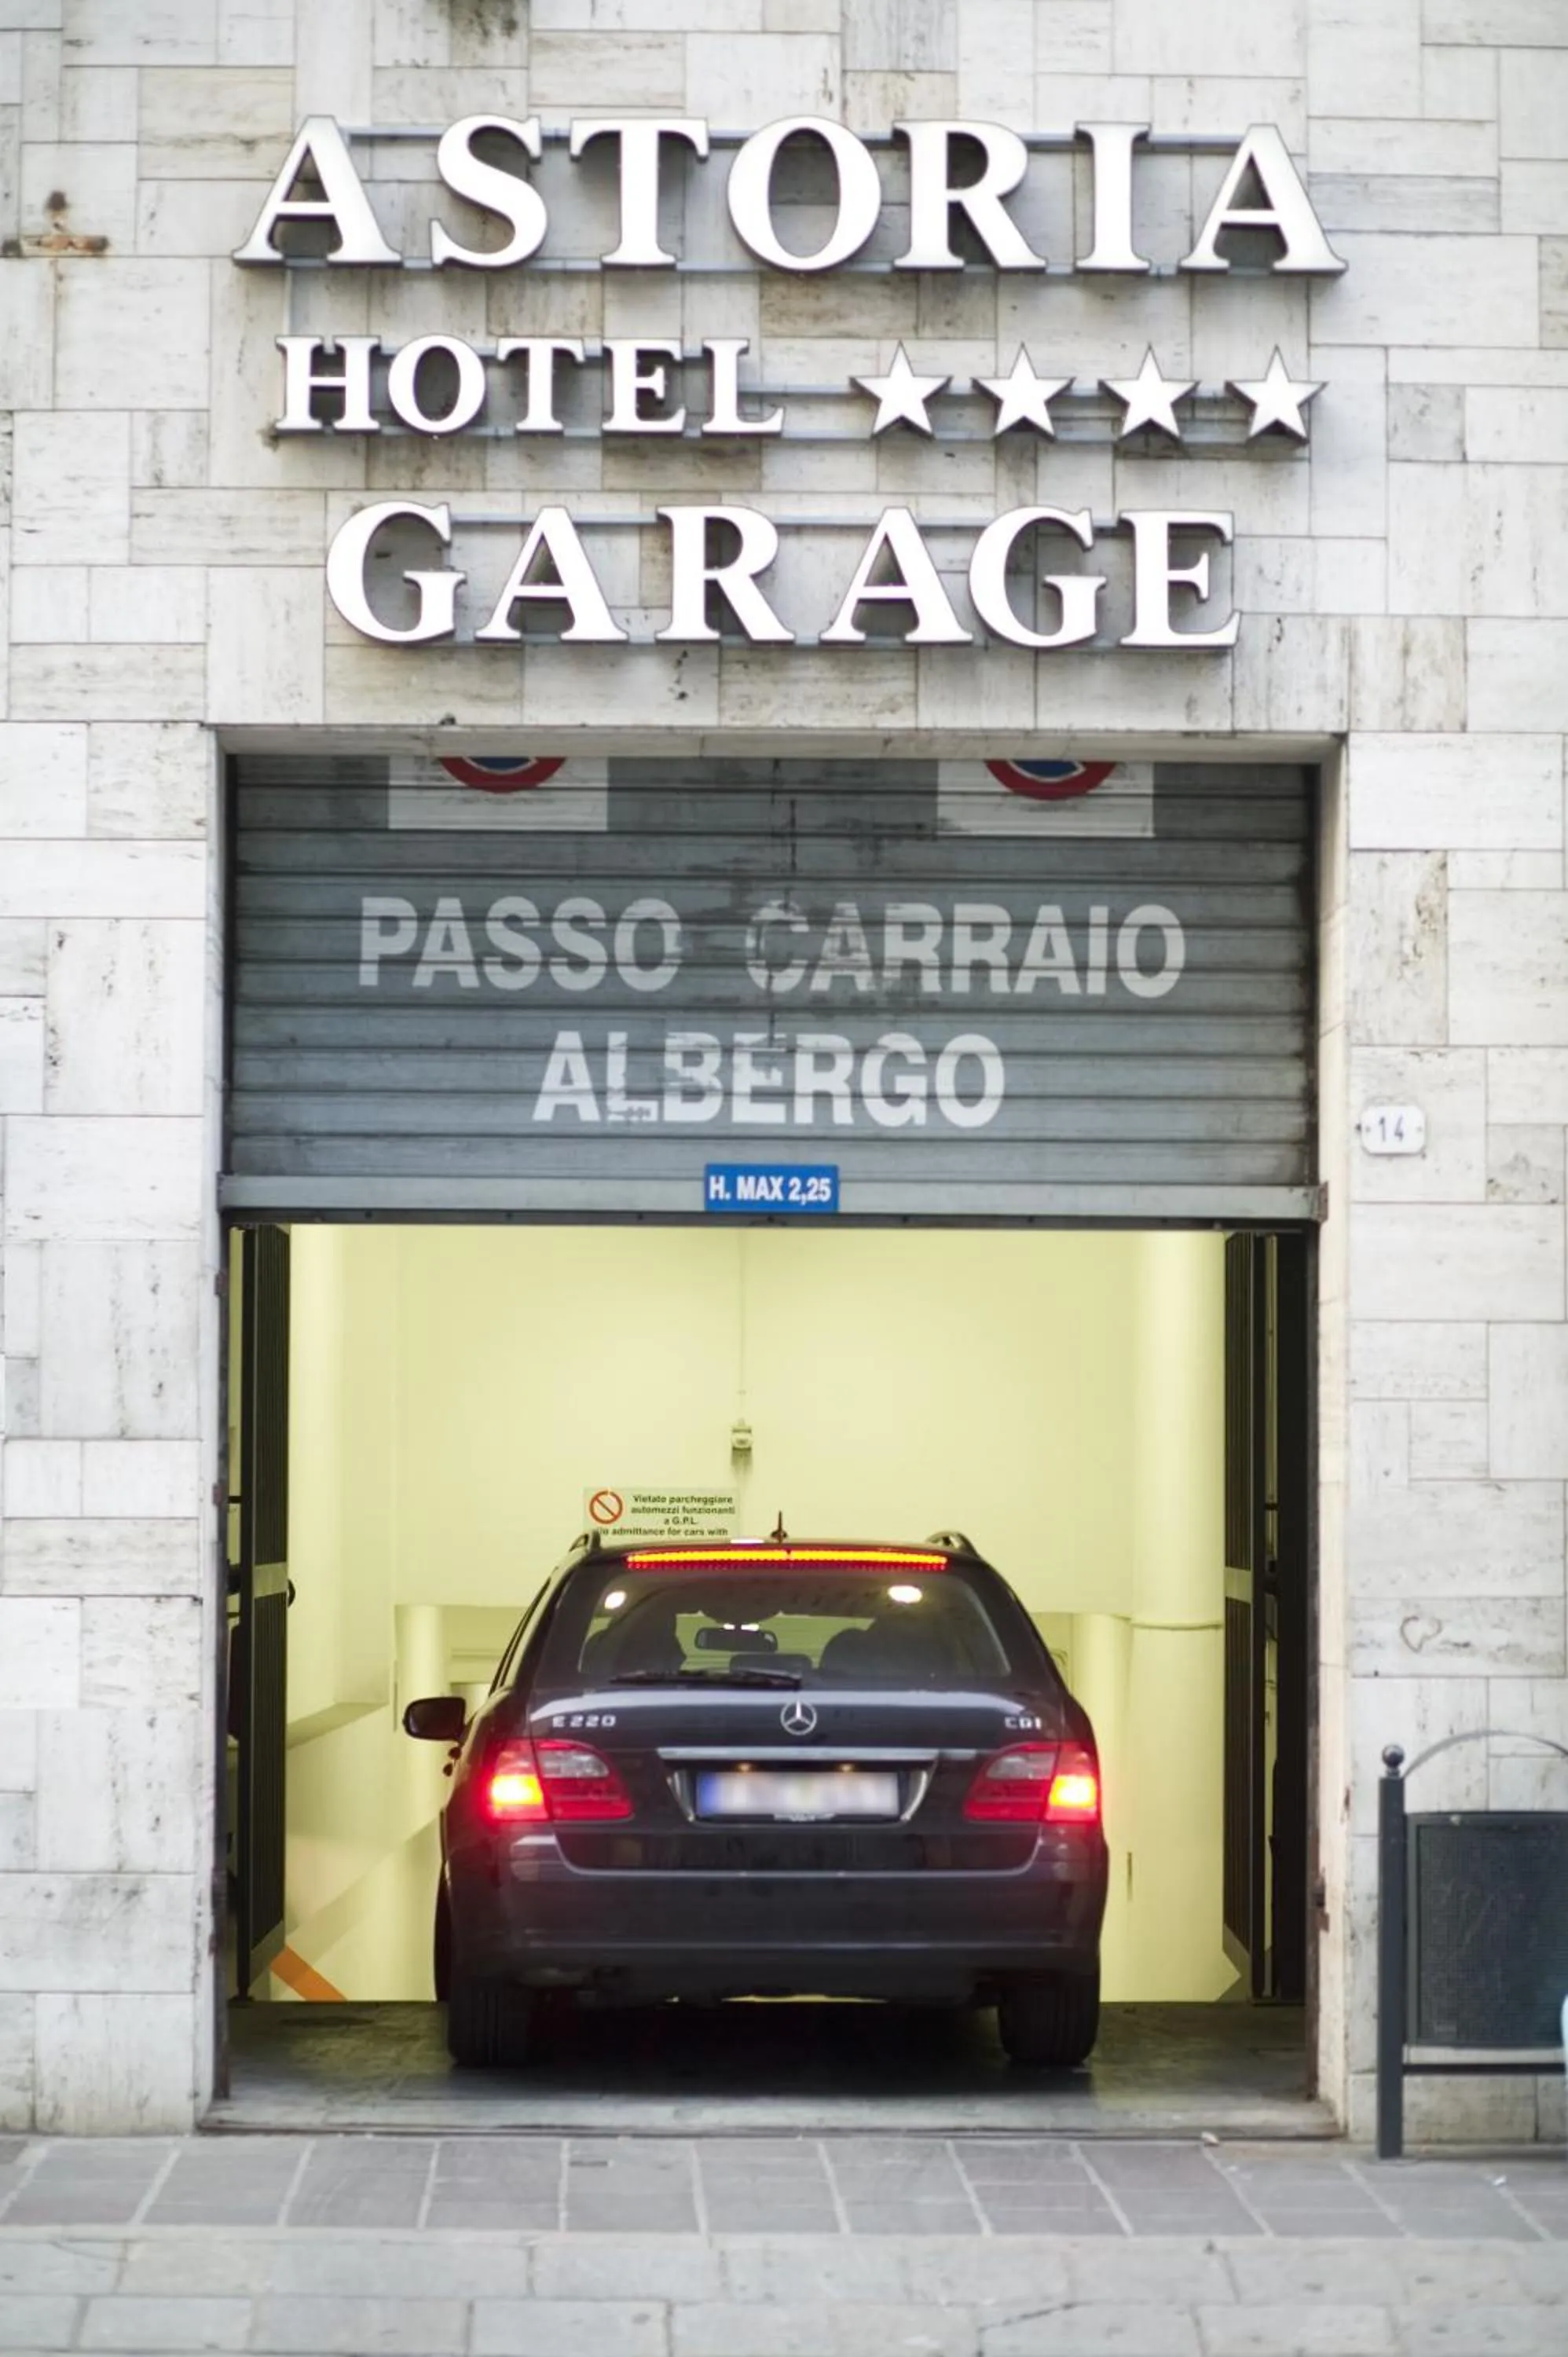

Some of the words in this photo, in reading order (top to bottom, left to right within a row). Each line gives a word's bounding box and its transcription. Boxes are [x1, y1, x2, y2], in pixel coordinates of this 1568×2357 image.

[233, 115, 1348, 273] ASTORIA
[275, 334, 784, 434] HOTEL
[326, 500, 1241, 649] GARAGE
[358, 896, 682, 992] PASSO
[746, 900, 1185, 998] CARRAIO
[532, 1030, 1005, 1127] ALBERGO
[1378, 1113, 1405, 1142] 14
[709, 1175, 731, 1200] H.
[737, 1175, 784, 1201] MAX
[788, 1177, 832, 1206] 2,25
[632, 1495, 666, 1504] Vietato
[669, 1495, 733, 1505] parcheggiare
[611, 1527, 665, 1535] admittance
[668, 1527, 681, 1535] for
[707, 1527, 728, 1535] with
[552, 1715, 565, 1728] E
[570, 1714, 616, 1728] 220
[1005, 1716, 1042, 1730] CDI
